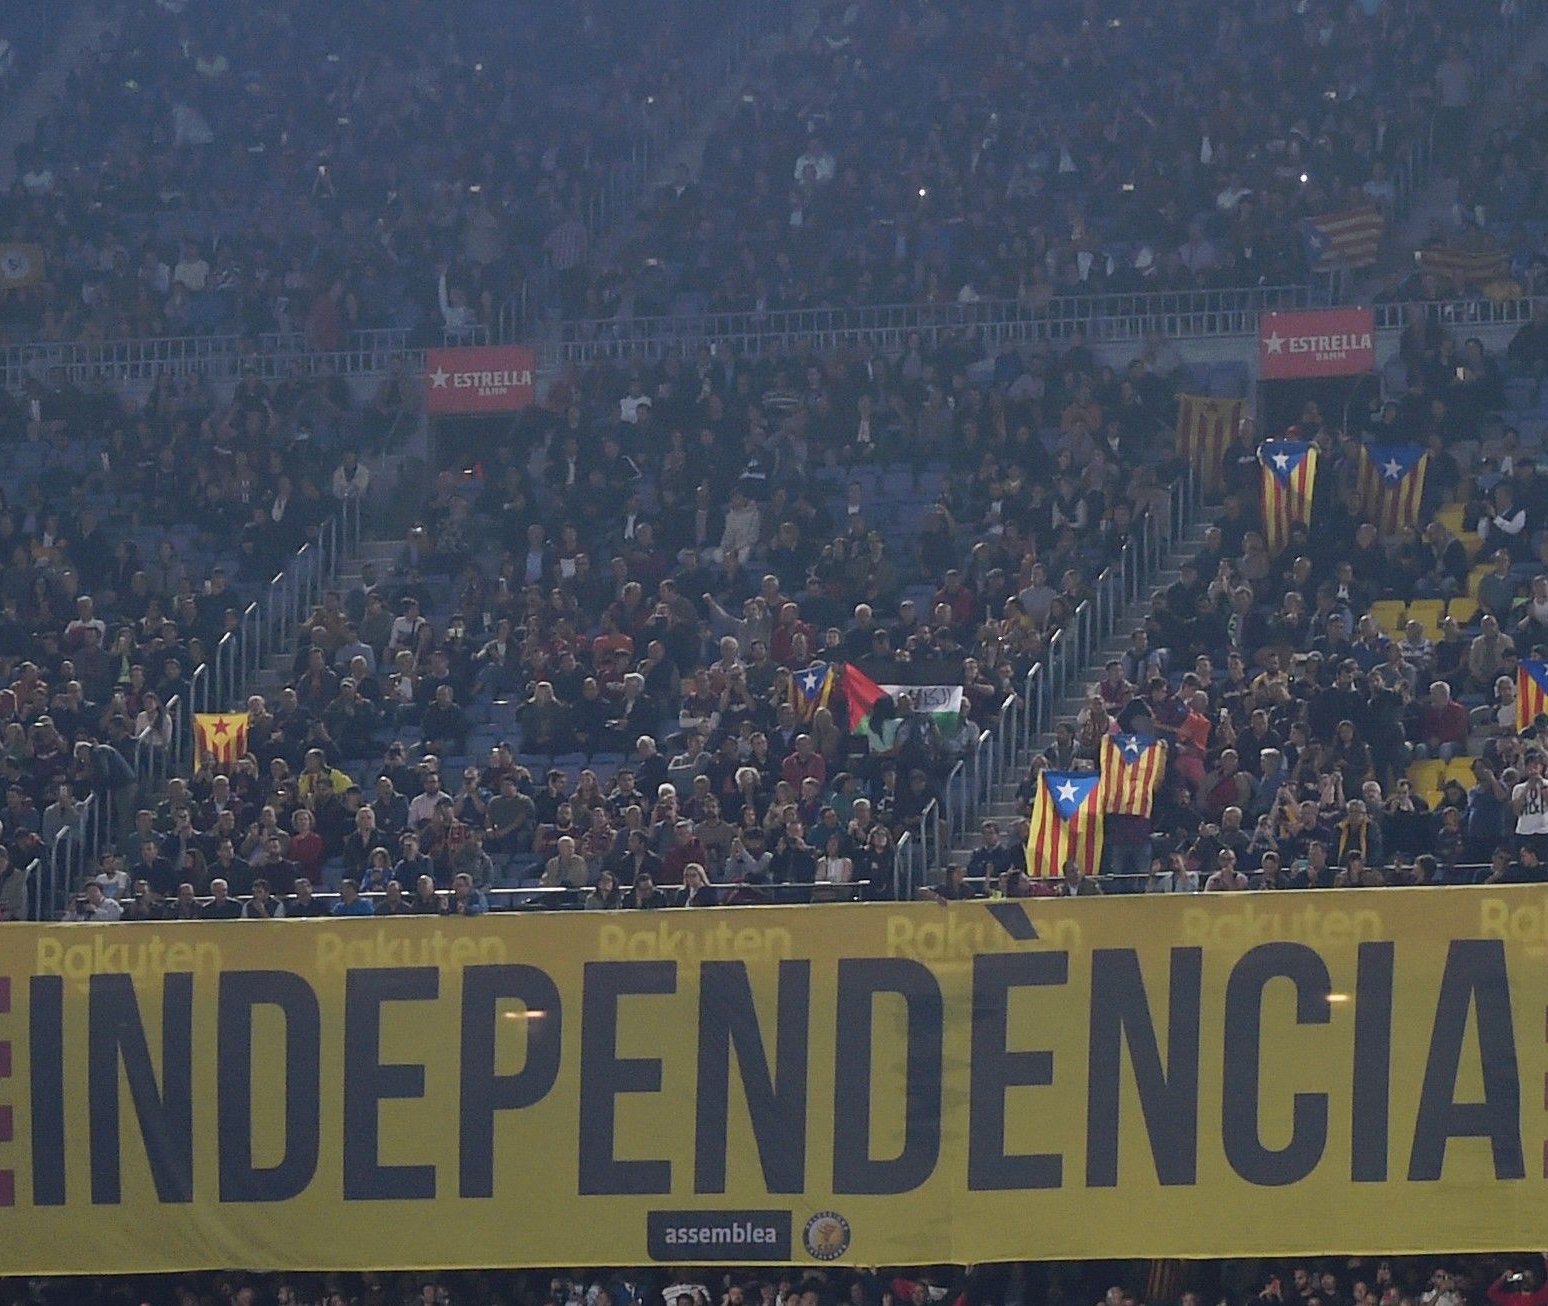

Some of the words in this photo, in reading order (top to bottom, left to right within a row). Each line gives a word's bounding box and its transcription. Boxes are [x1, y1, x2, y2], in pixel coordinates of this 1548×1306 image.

[1289, 334, 1372, 352] ESTRELLA
[454, 370, 532, 387] ESTRELLA
[29, 903, 1526, 1206] INDEPENDÈNCIA
[665, 1225, 777, 1244] assemblea
